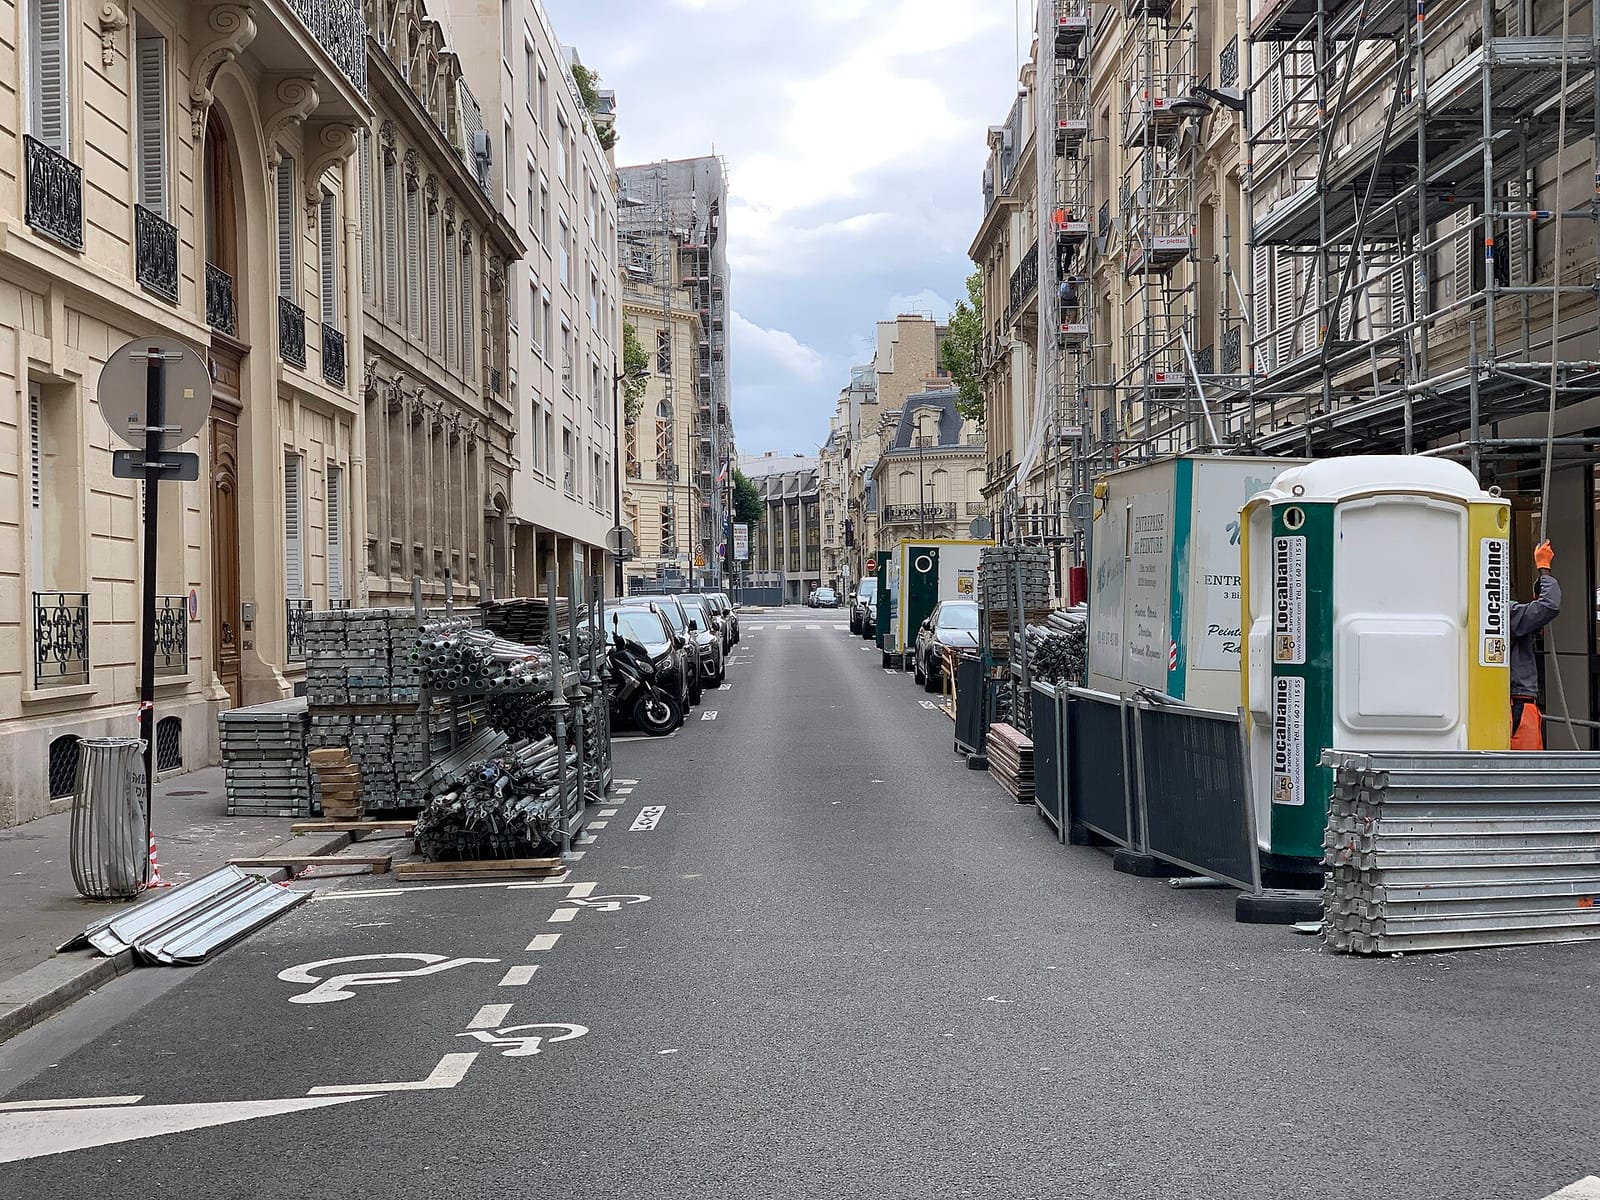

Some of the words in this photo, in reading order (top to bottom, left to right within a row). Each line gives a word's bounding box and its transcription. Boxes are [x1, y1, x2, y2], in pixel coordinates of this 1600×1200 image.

[1296, 538, 1301, 546] 55
[1296, 548, 1301, 556] 15
[1296, 559, 1301, 567] 21
[1296, 569, 1301, 577] 60
[1204, 575, 1241, 586] ENTR
[1296, 579, 1301, 587] 01
[1276, 539, 1288, 633] Locabane
[1485, 541, 1501, 635] Locabane
[1223, 591, 1229, 599] 3
[1294, 679, 1301, 688] 55
[1294, 689, 1301, 697] 15
[1294, 700, 1301, 708] 21
[1294, 710, 1301, 719] 60
[1274, 679, 1287, 773] Locabane
[1294, 720, 1301, 729] 01
